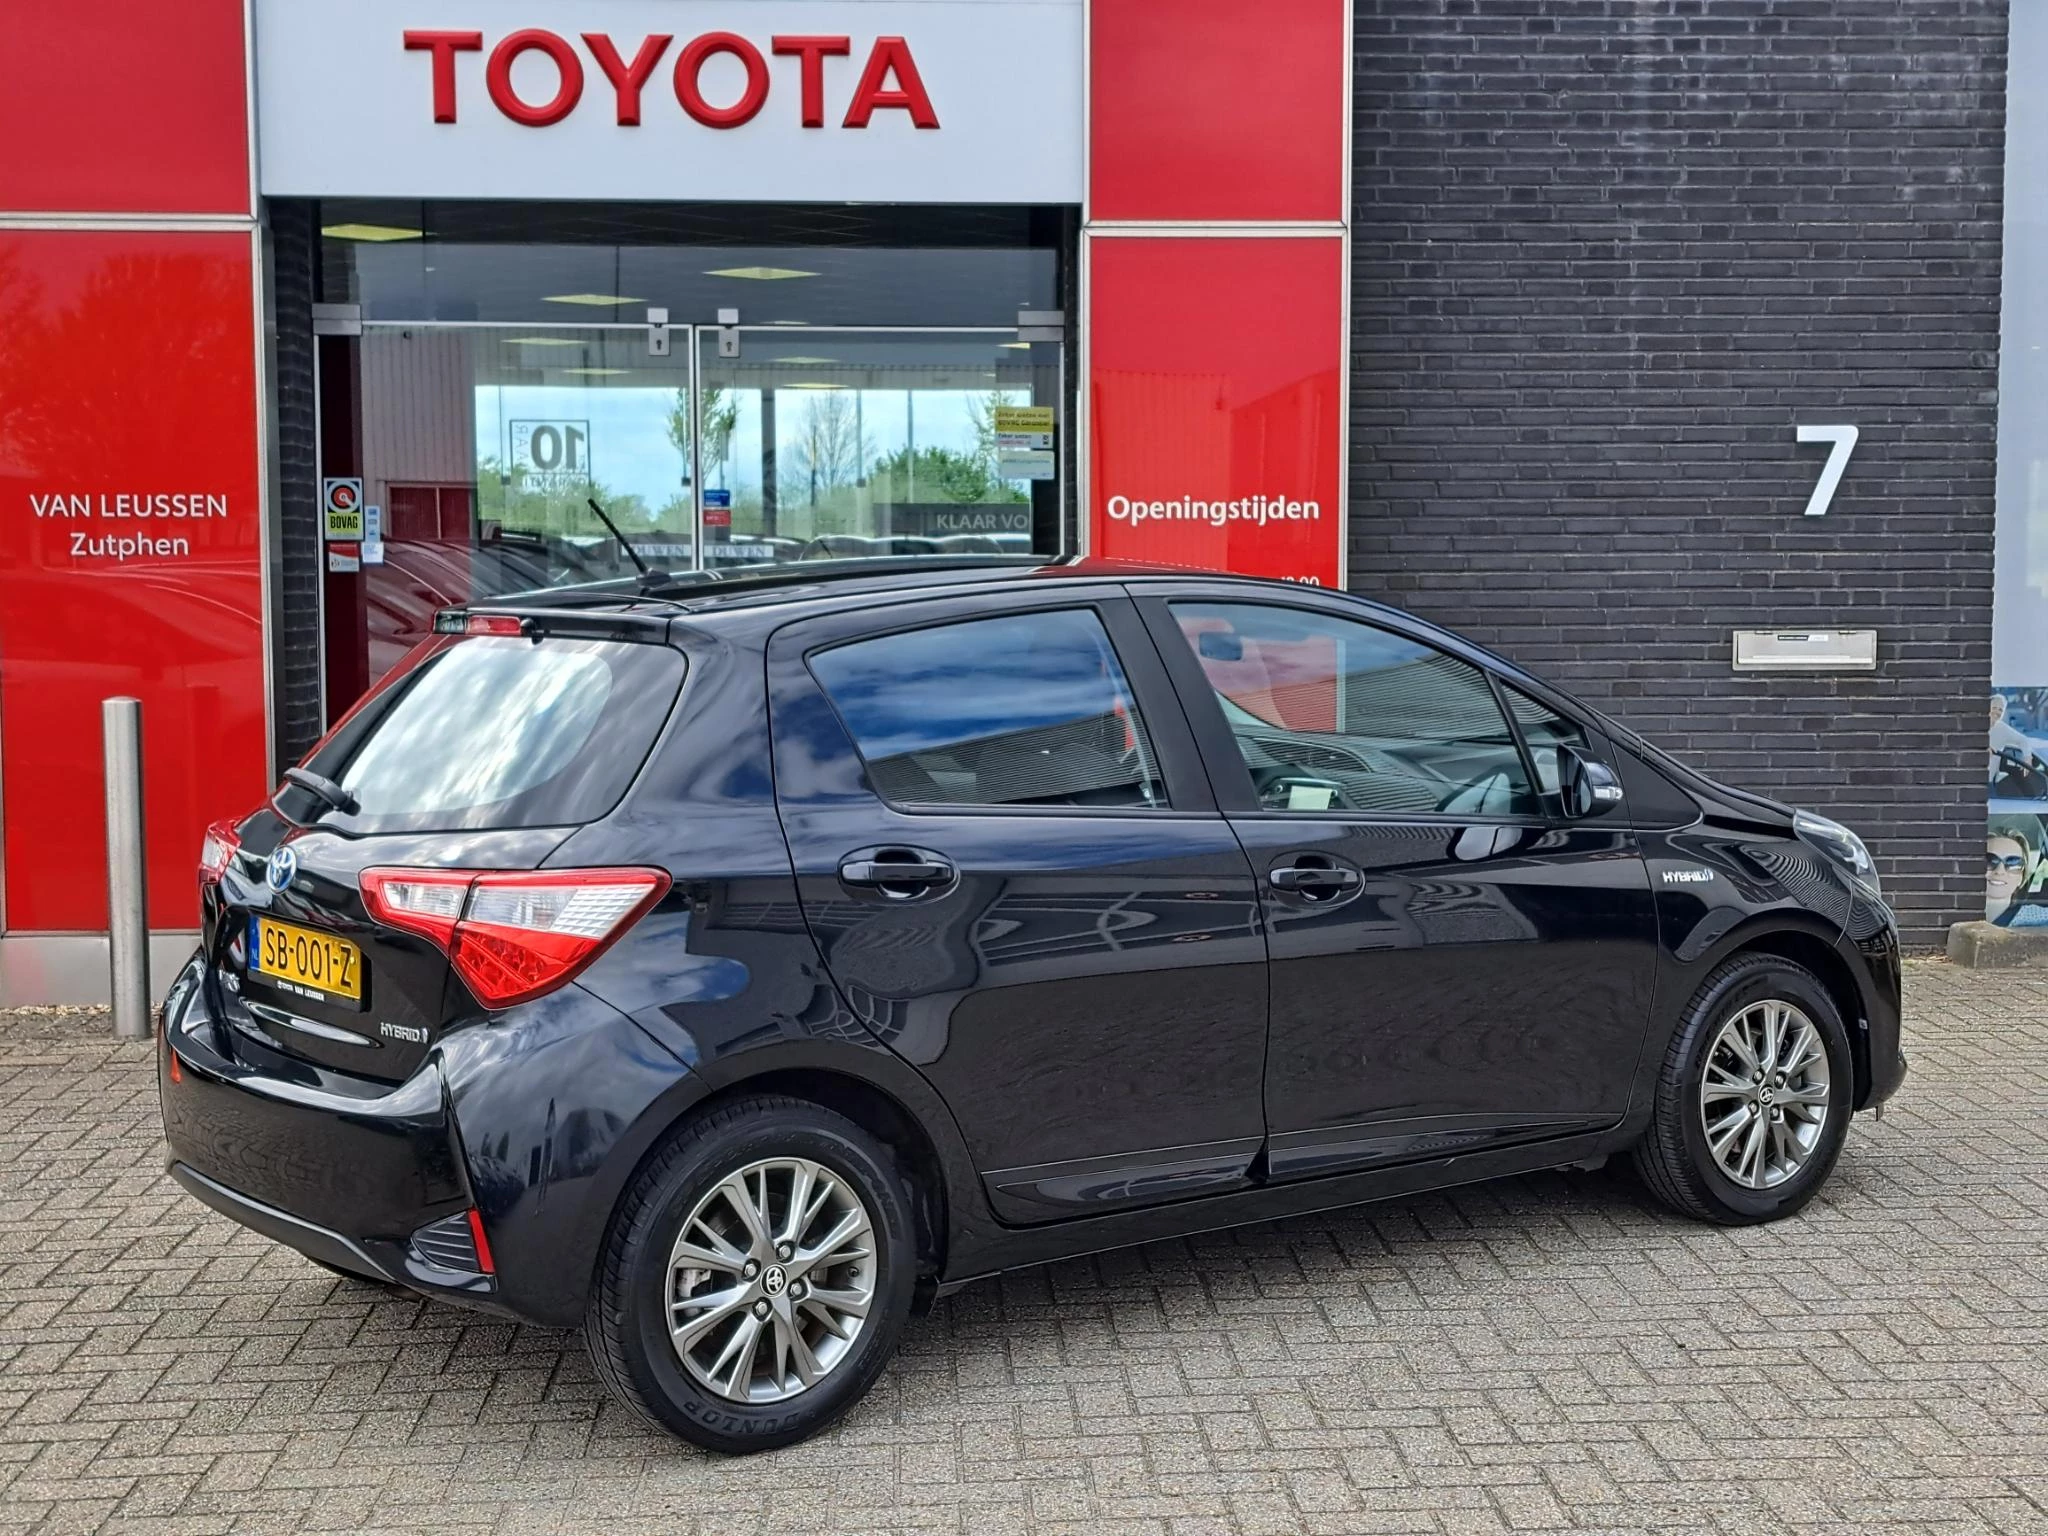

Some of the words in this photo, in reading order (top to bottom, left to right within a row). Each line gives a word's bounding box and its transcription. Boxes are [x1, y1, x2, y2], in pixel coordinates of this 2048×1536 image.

[403, 28, 941, 130] TOYOTA
[1797, 425, 1859, 516] 7
[29, 494, 91, 518] VAN
[100, 494, 227, 518] LEUSSEN
[1107, 495, 1320, 527] Openingstijden
[329, 515, 358, 529] BOVAG
[936, 513, 997, 529] KLAAR
[1000, 513, 1028, 529] VO
[70, 532, 189, 561] Zutphen
[1662, 869, 1707, 883] HYBRID
[266, 926, 353, 989] SB-001-Z
[380, 1021, 420, 1043] HYBRID
[683, 1401, 801, 1434] DUNLOP
